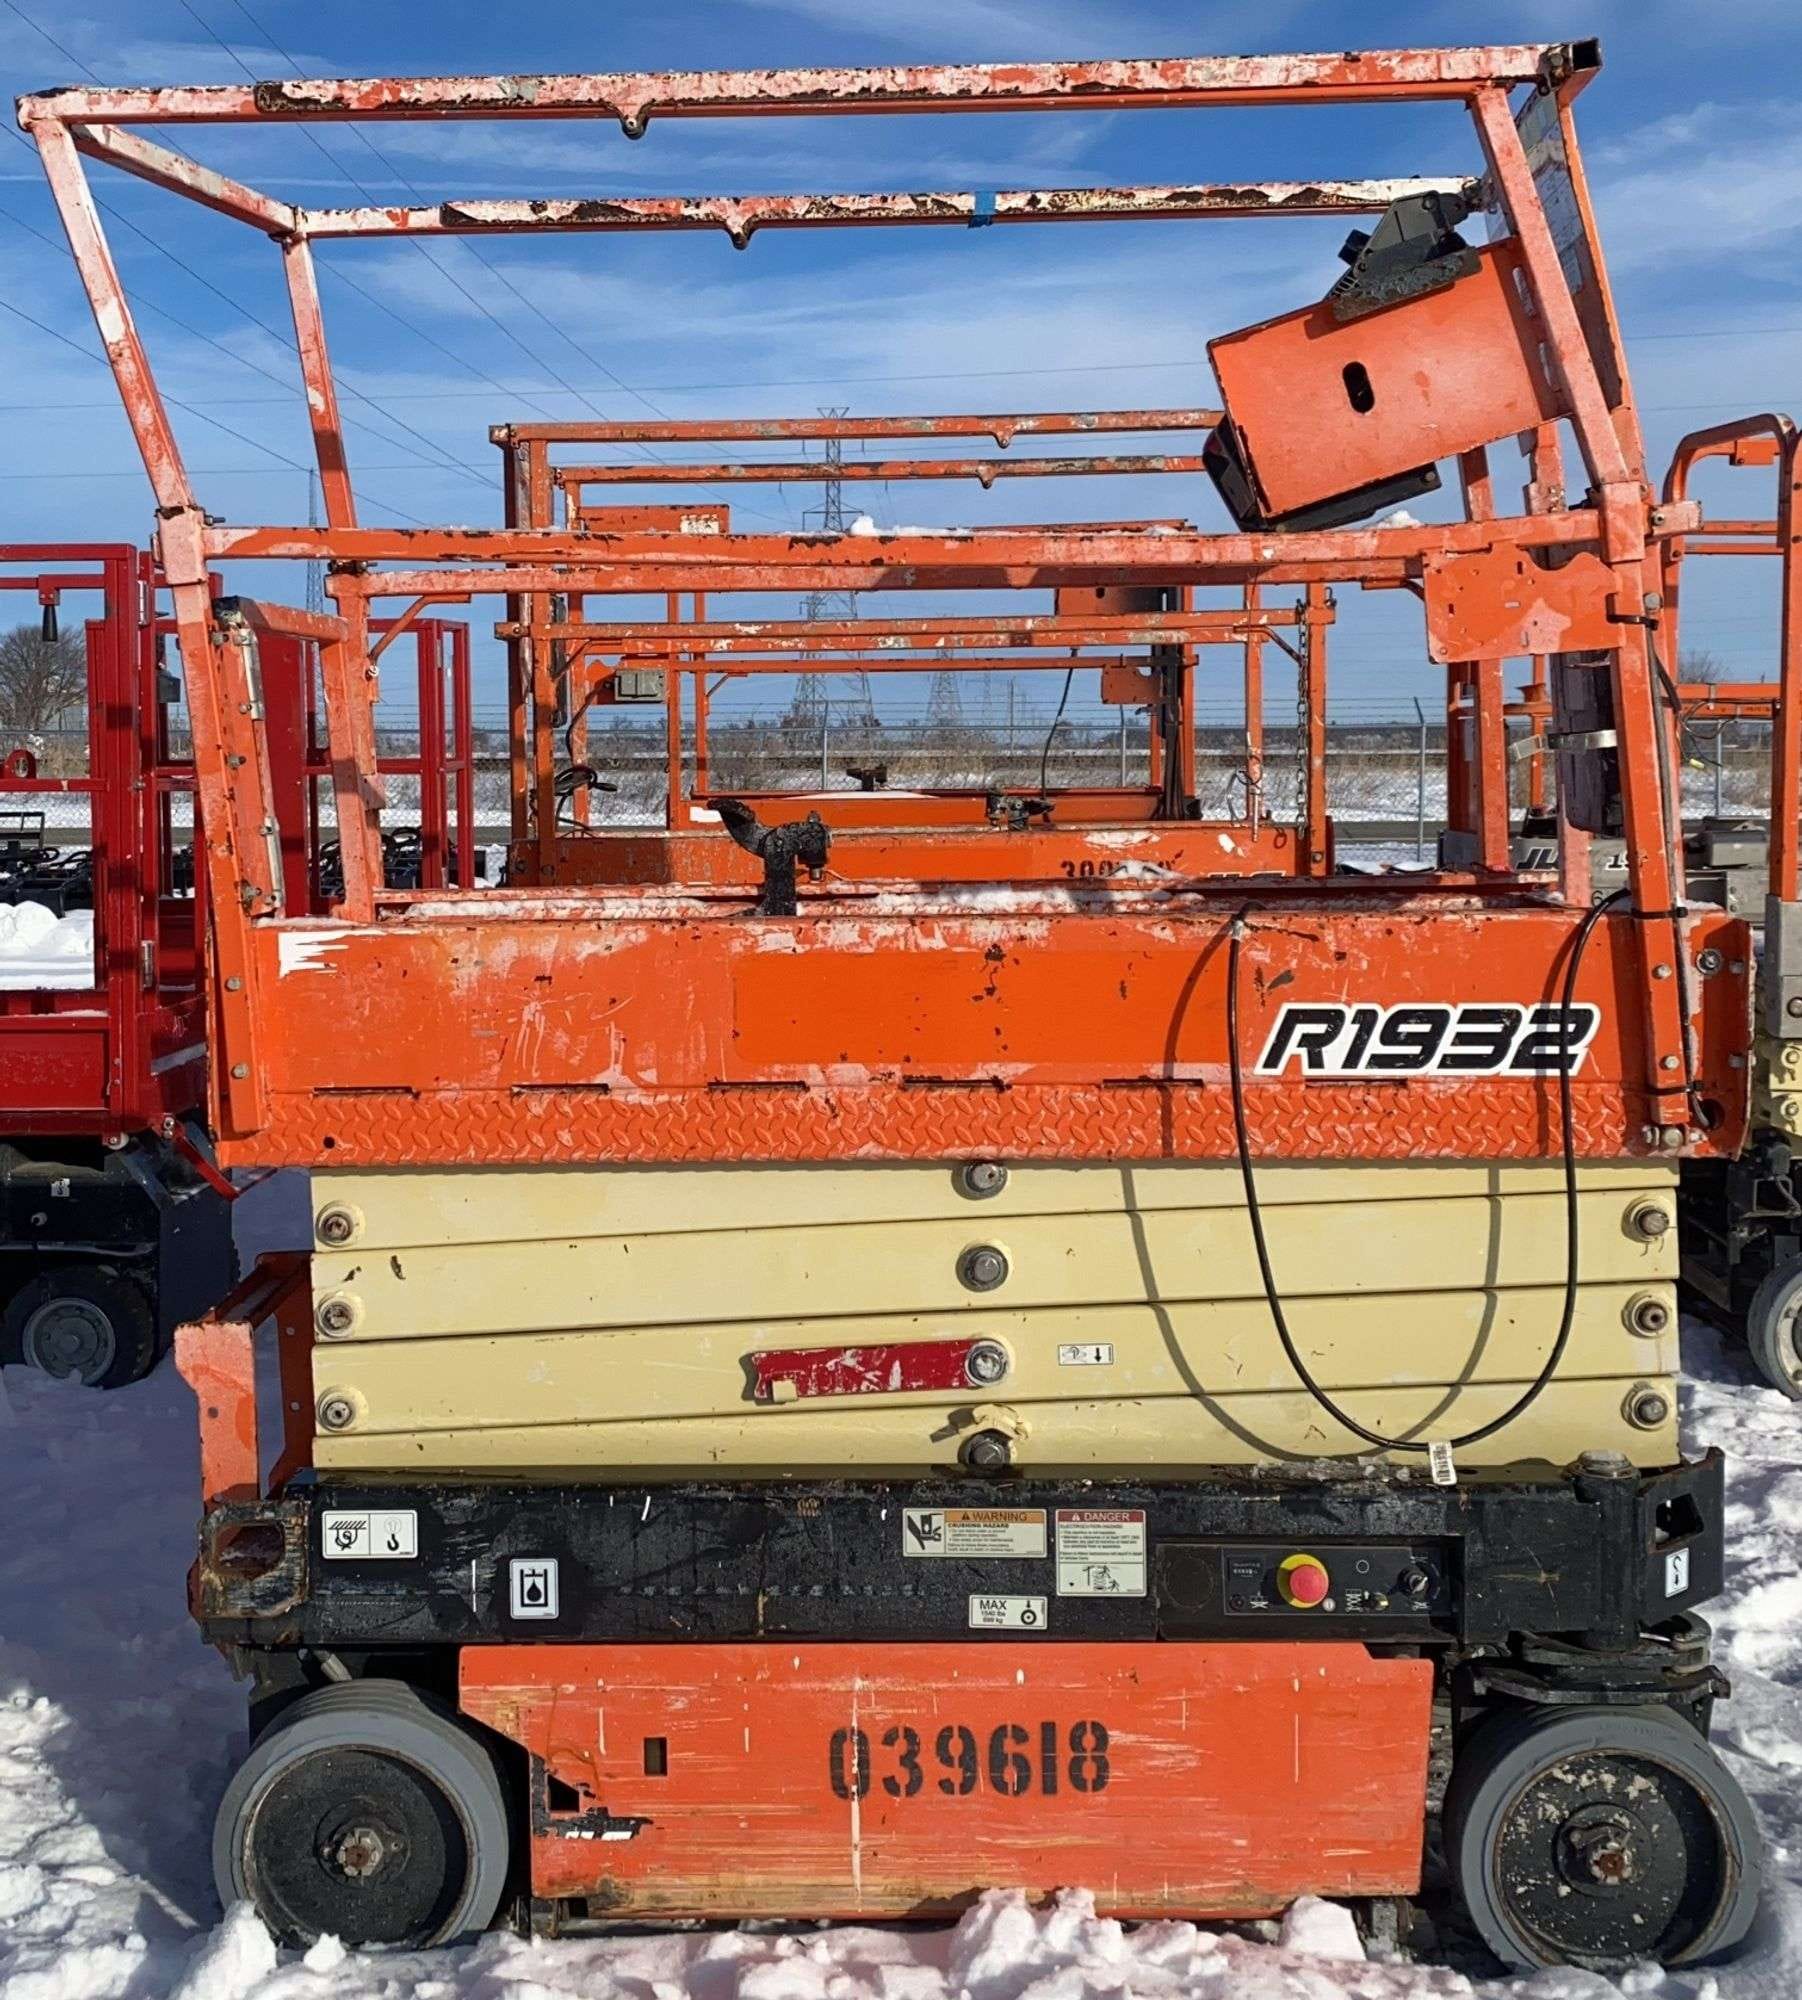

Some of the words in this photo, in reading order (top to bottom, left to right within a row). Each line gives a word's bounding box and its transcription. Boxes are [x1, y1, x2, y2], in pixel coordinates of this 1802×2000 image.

[1255, 1003, 1600, 1075] R1932
[972, 1511, 1028, 1522] WARNING
[1083, 1512, 1130, 1521] DANGER
[980, 1600, 1007, 1610] MAX
[829, 1721, 1110, 1800] 039618
